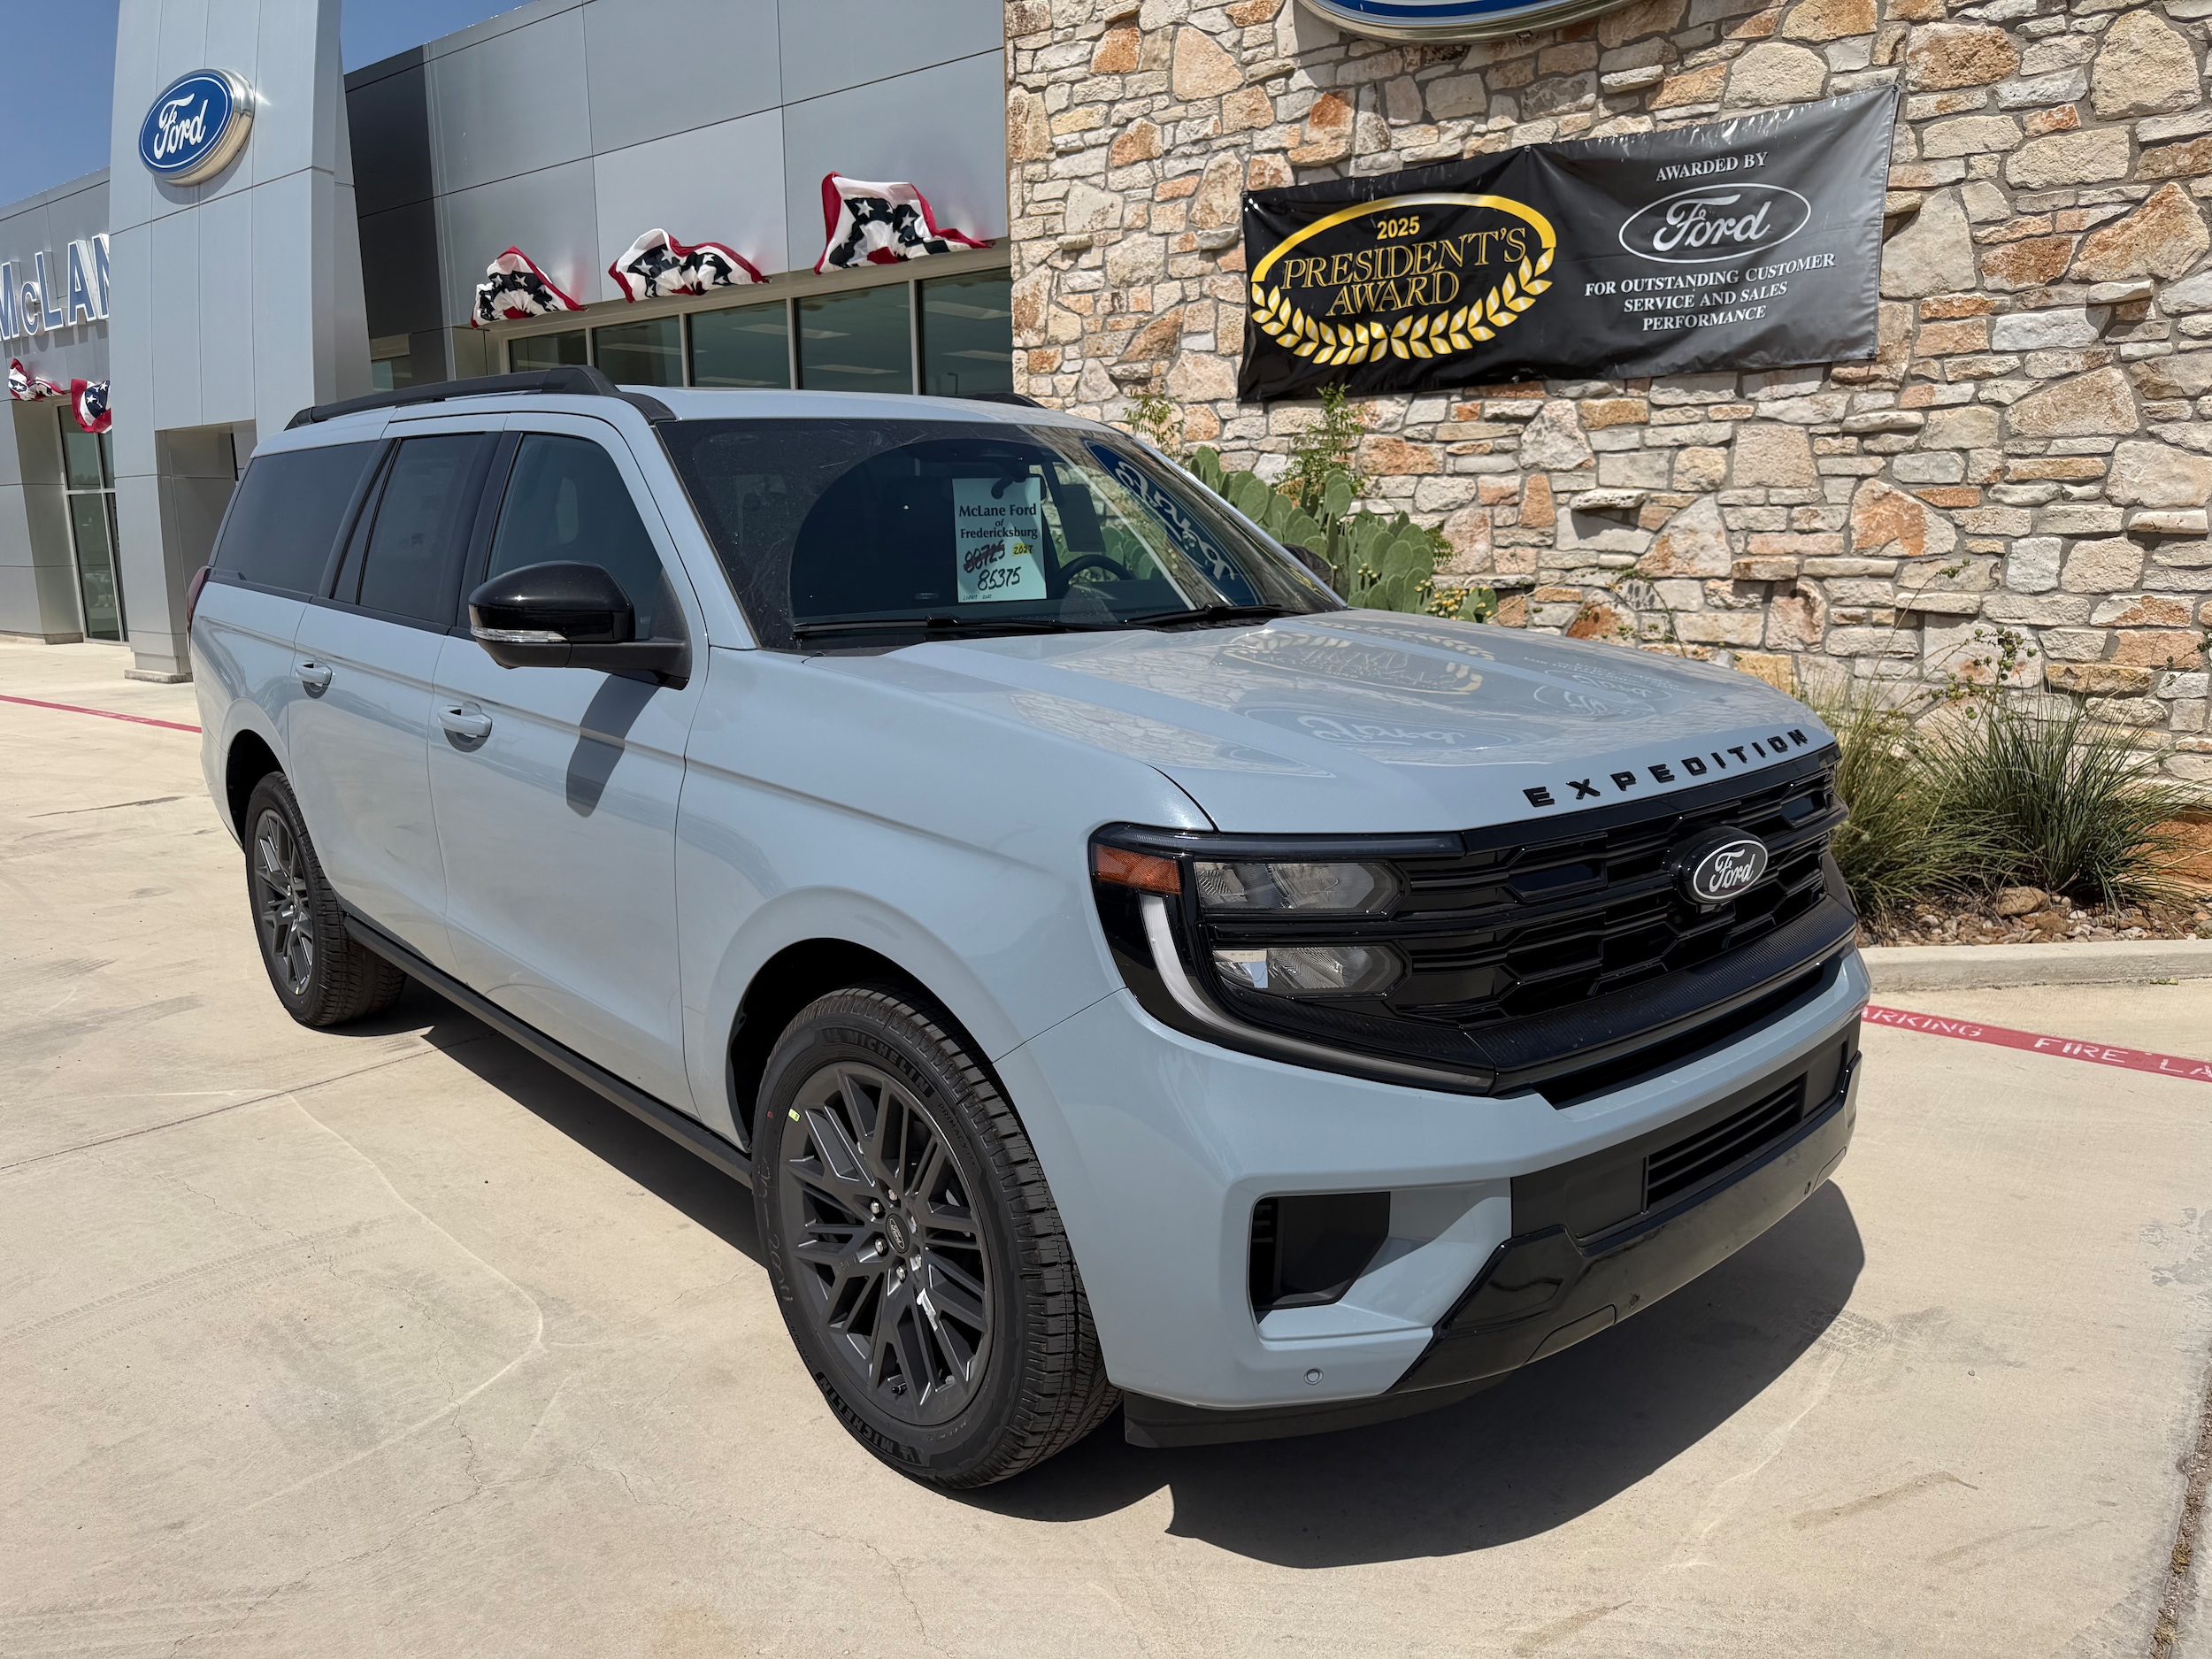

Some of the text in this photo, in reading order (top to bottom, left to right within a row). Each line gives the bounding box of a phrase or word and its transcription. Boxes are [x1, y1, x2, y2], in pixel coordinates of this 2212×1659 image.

[154, 92, 208, 159] Ford
[1655, 151, 1769, 182] AWARDED BY
[1377, 216, 1420, 240] 2025
[1653, 194, 1772, 252] Ford
[1280, 227, 1526, 290] PRESIDENT'S
[1585, 253, 1836, 296] FOR OUTSTANDING CUSTOMER
[0, 234, 109, 342] McLAN
[1325, 271, 1460, 317] AWARD
[1624, 281, 1788, 313] SERVICE AND SALES
[1642, 305, 1767, 331] PERFORMANCE
[959, 503, 1037, 518] McLane Ford
[995, 518, 1005, 527] of
[960, 527, 1038, 540] Fredericksburg
[1013, 545, 1033, 555] 2027
[978, 566, 1022, 591] 85375
[1522, 728, 1809, 808] EXPEDITION
[1709, 849, 1757, 893] Ford
[847, 1031, 930, 1094] MICHELIN
[1862, 1007, 2212, 1078] RKING FIRE LA
[938, 1102, 968, 1149] PRIMACY
[819, 1378, 895, 1454] MICHELIN
